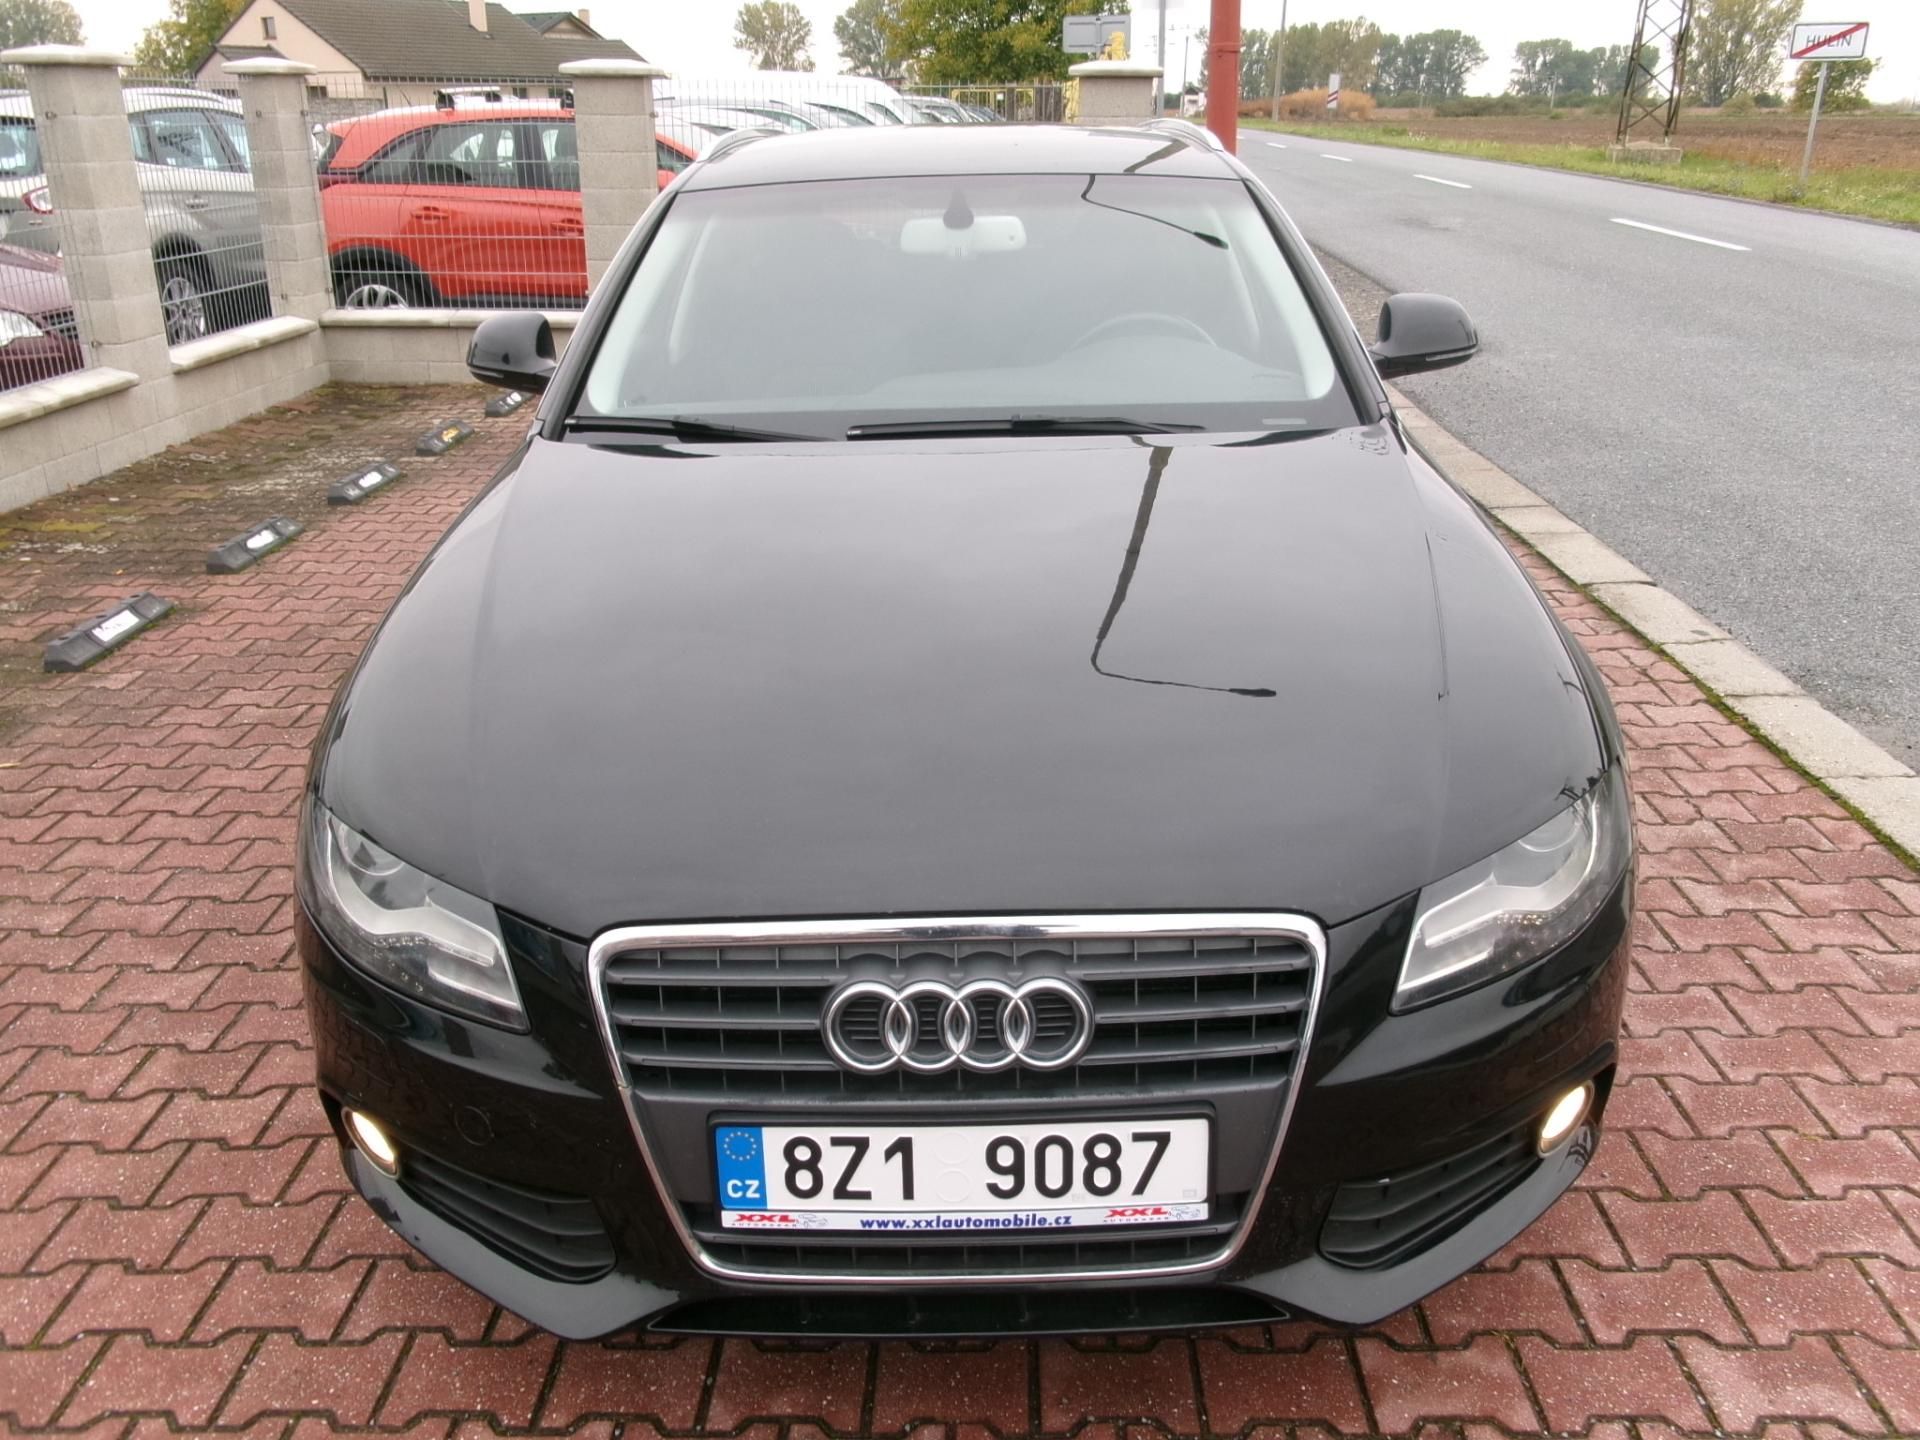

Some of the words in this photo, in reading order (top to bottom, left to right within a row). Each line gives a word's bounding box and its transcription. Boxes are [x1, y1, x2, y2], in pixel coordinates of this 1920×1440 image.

[783, 1135, 915, 1201] 8Z1
[984, 1131, 1172, 1200] 9087
[727, 1179, 761, 1199] CZ
[734, 1213, 796, 1223] XXL
[1104, 1206, 1168, 1218] XXL
[860, 1213, 1072, 1229] www.xxlautomobile.cz
